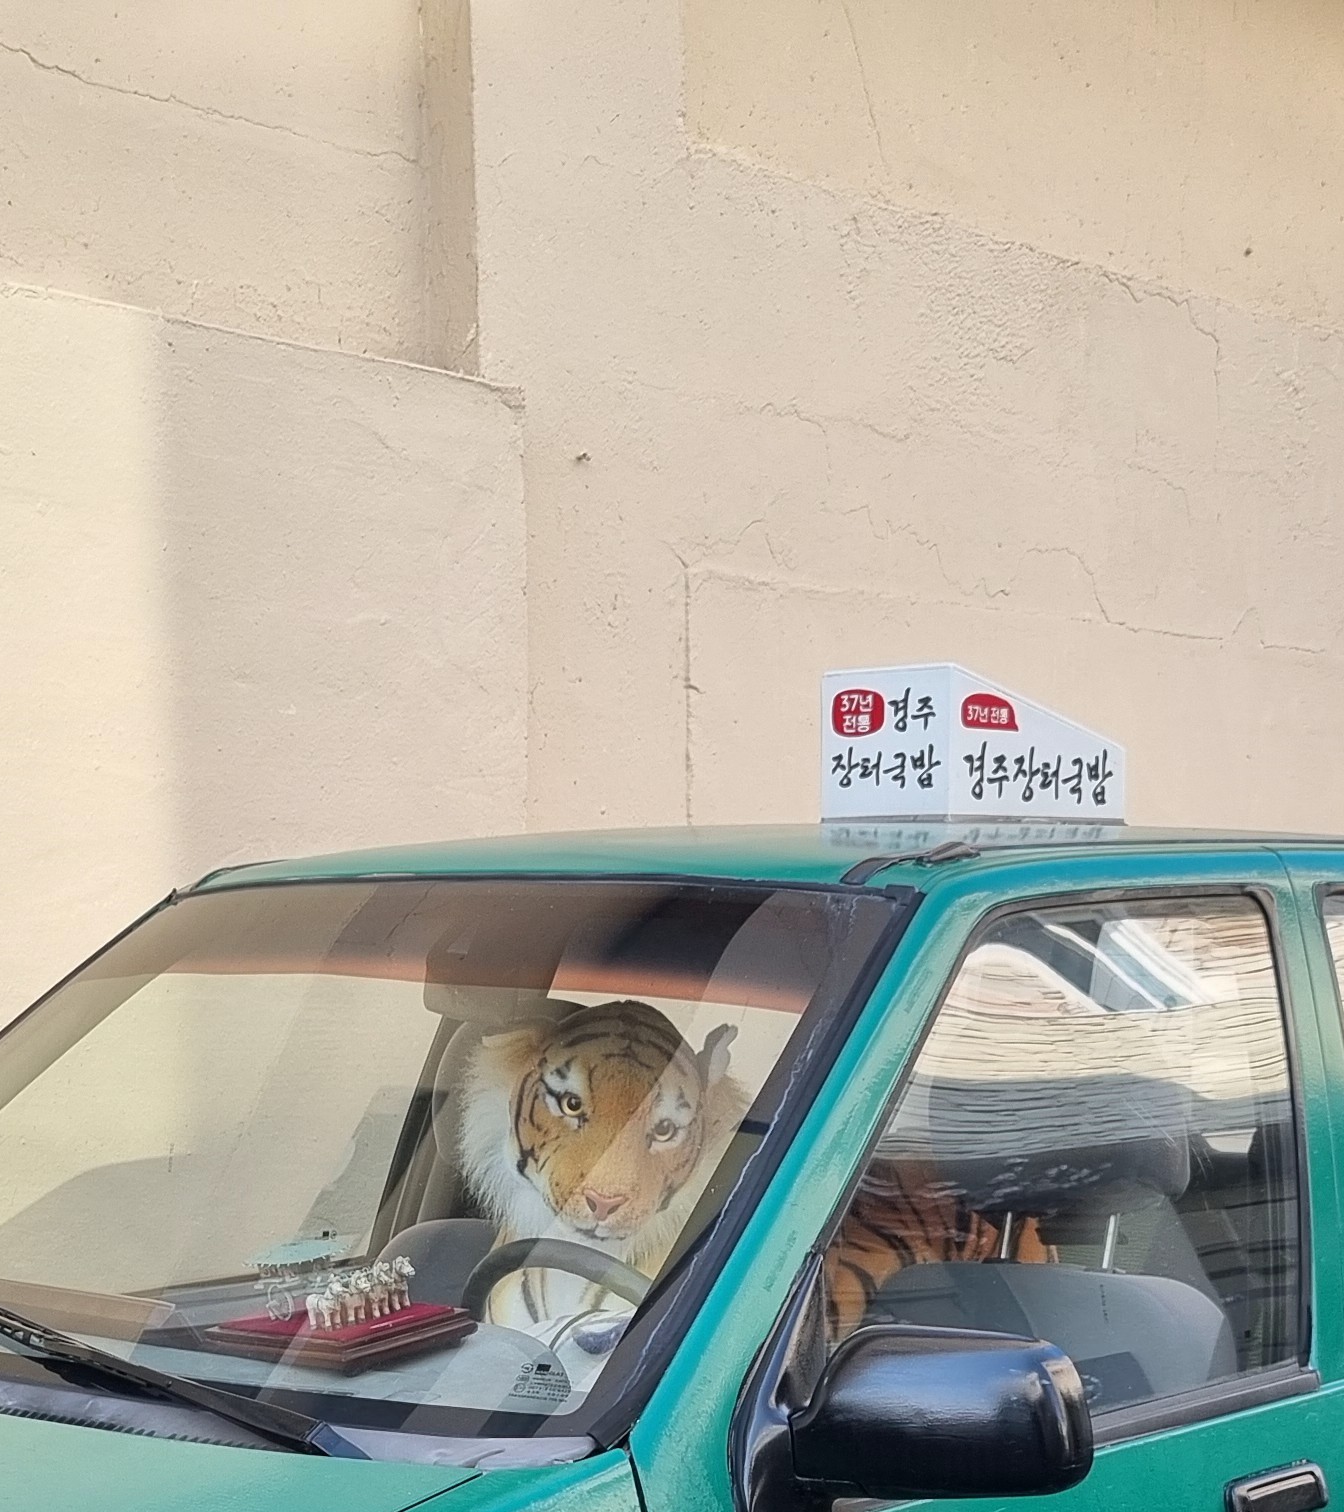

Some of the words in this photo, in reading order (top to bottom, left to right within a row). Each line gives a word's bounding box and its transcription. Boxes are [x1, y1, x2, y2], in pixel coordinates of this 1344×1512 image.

[840, 694, 874, 712] 37년
[887, 687, 937, 733] 경주
[967, 705, 988, 723] 37년
[990, 708, 1009, 724] 전통
[843, 714, 871, 733] 전통
[831, 743, 942, 789] 장터국밥
[962, 741, 1114, 806] 경주장터국밥
